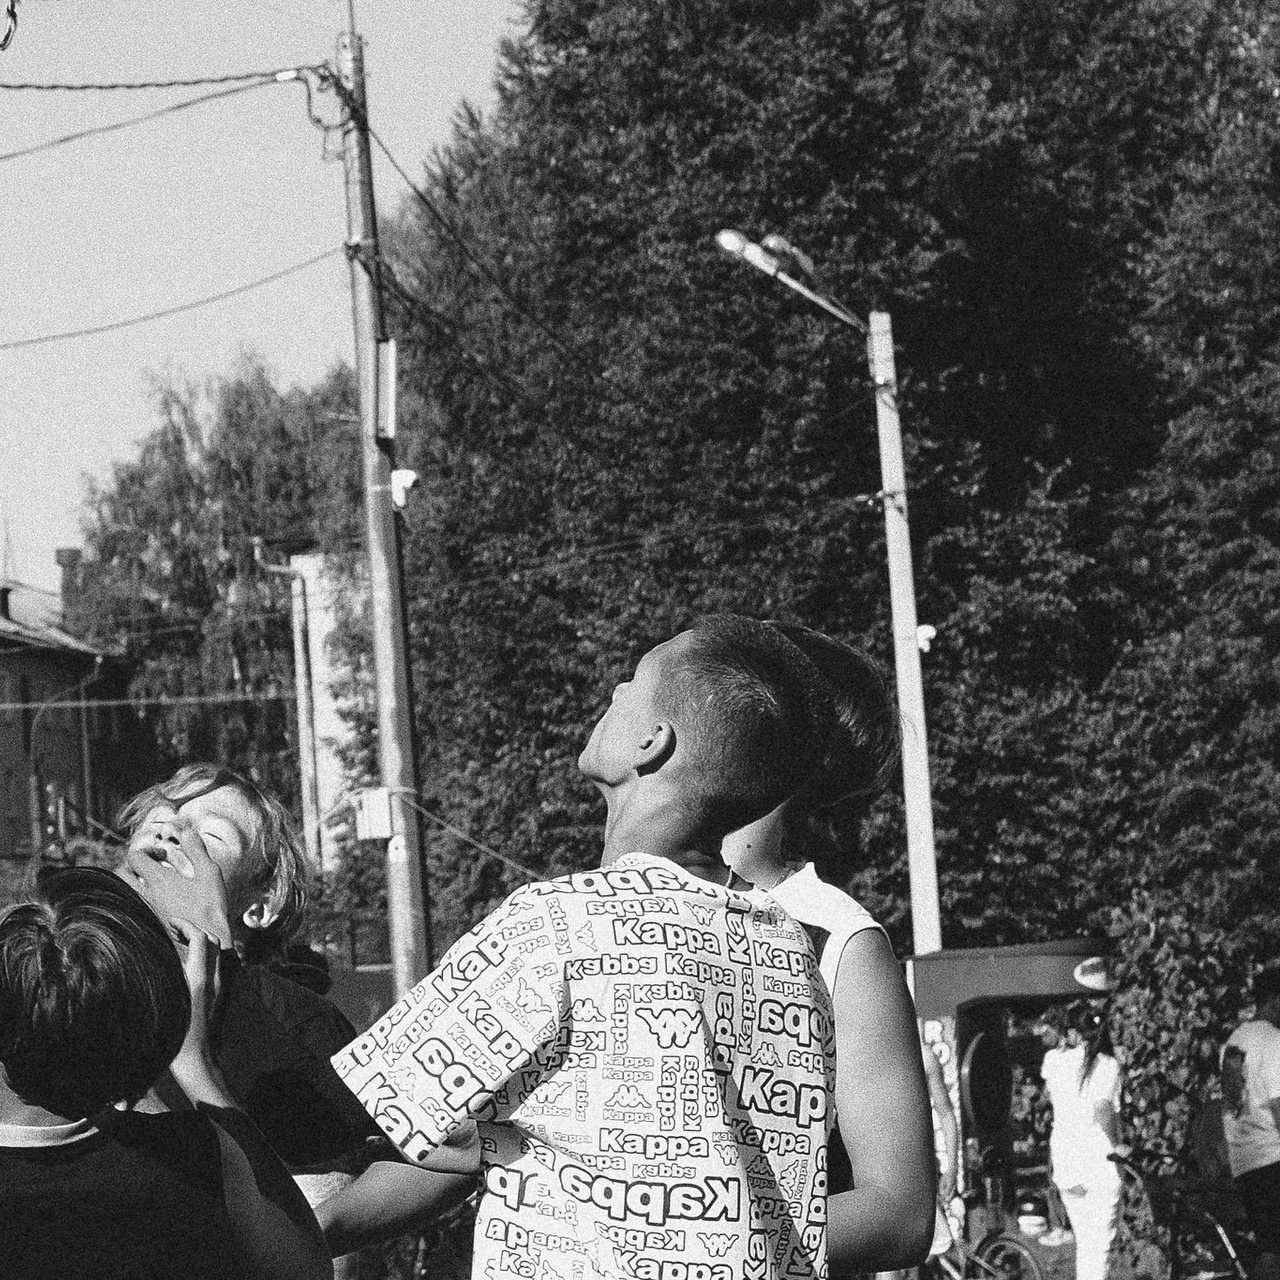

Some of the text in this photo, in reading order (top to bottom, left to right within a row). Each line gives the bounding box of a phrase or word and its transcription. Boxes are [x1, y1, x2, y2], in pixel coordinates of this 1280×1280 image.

[546, 897, 572, 955] Kappa
[613, 918, 721, 955] Kappa
[665, 953, 736, 987] Kappa
[763, 975, 811, 998] Kappa
[611, 983, 631, 1055] Kappa
[738, 967, 756, 1055] Kappa
[382, 998, 449, 1067] Kappa
[447, 1022, 502, 1080] Kappa
[602, 1068, 654, 1081] Kappa
[603, 1054, 654, 1068] Kappa
[657, 1055, 681, 1131] Kappa
[603, 1109, 654, 1123] Kappa
[599, 1128, 709, 1160] Kappa
[731, 1118, 810, 1156] Kappa
